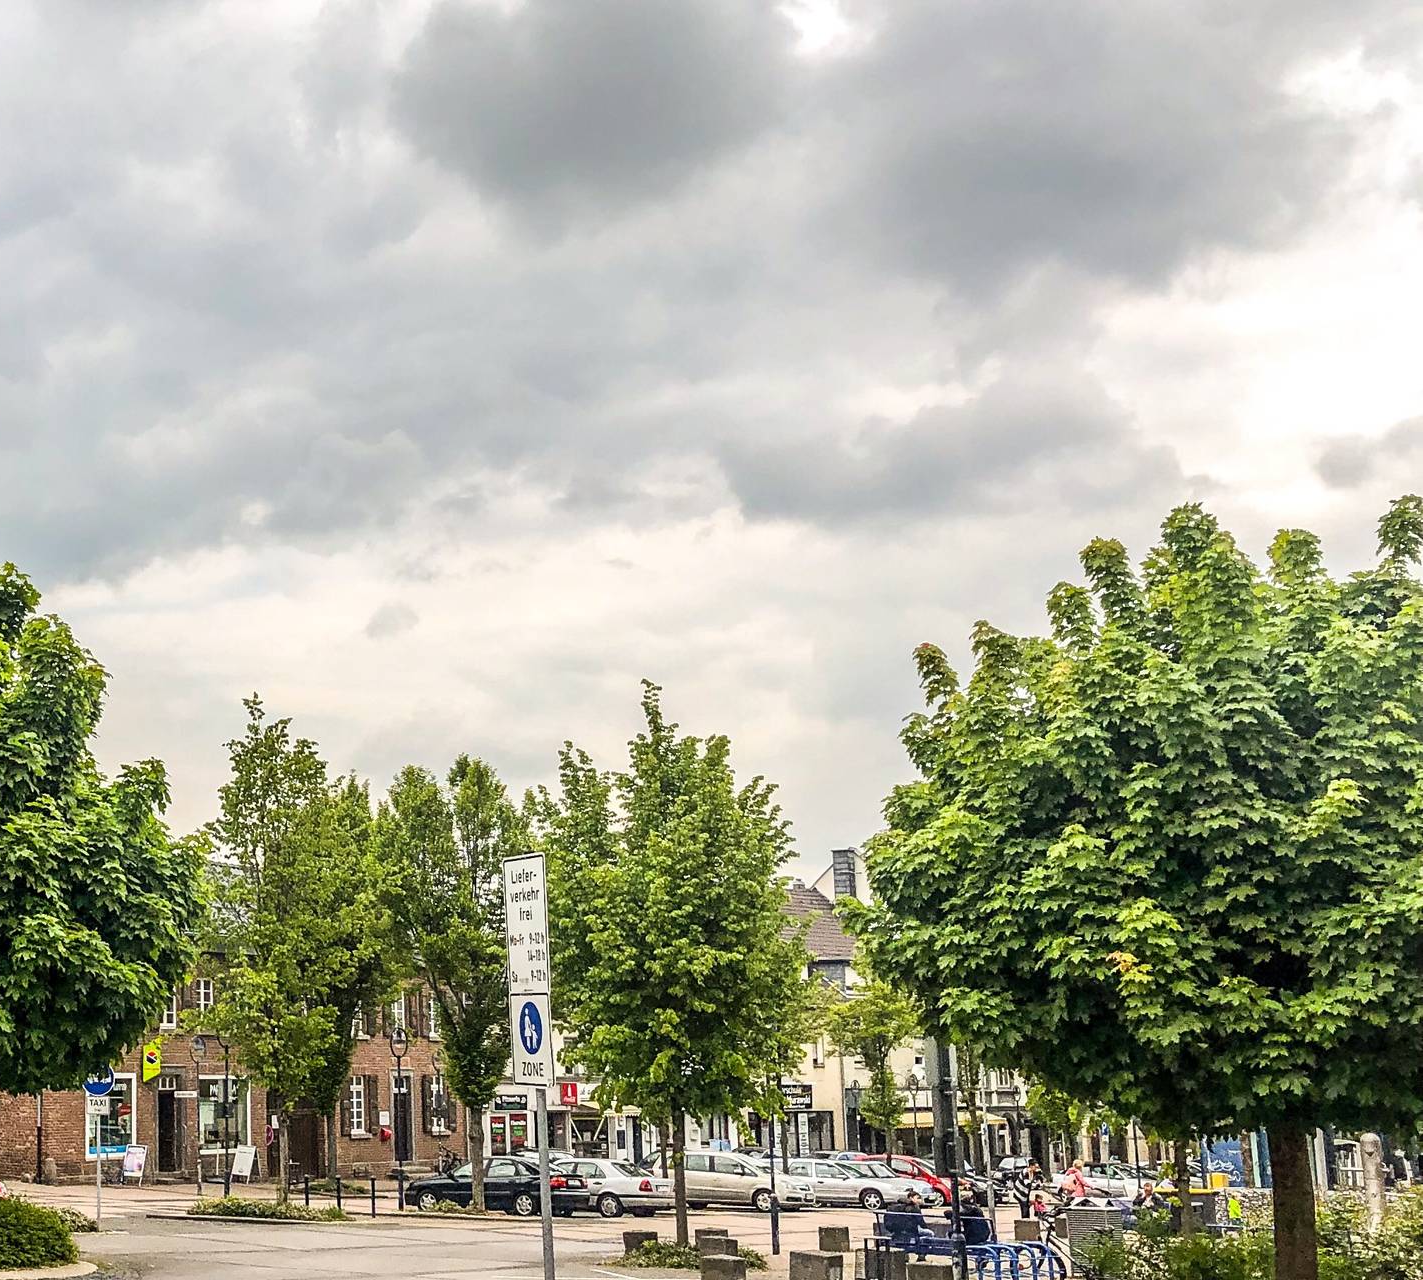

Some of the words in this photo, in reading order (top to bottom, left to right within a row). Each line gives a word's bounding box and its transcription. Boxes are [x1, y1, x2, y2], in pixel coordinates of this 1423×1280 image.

[510, 868, 537, 884] Liefer-
[509, 887, 539, 903] verkehr
[519, 906, 533, 920] frei
[522, 1061, 544, 1077] ZONE
